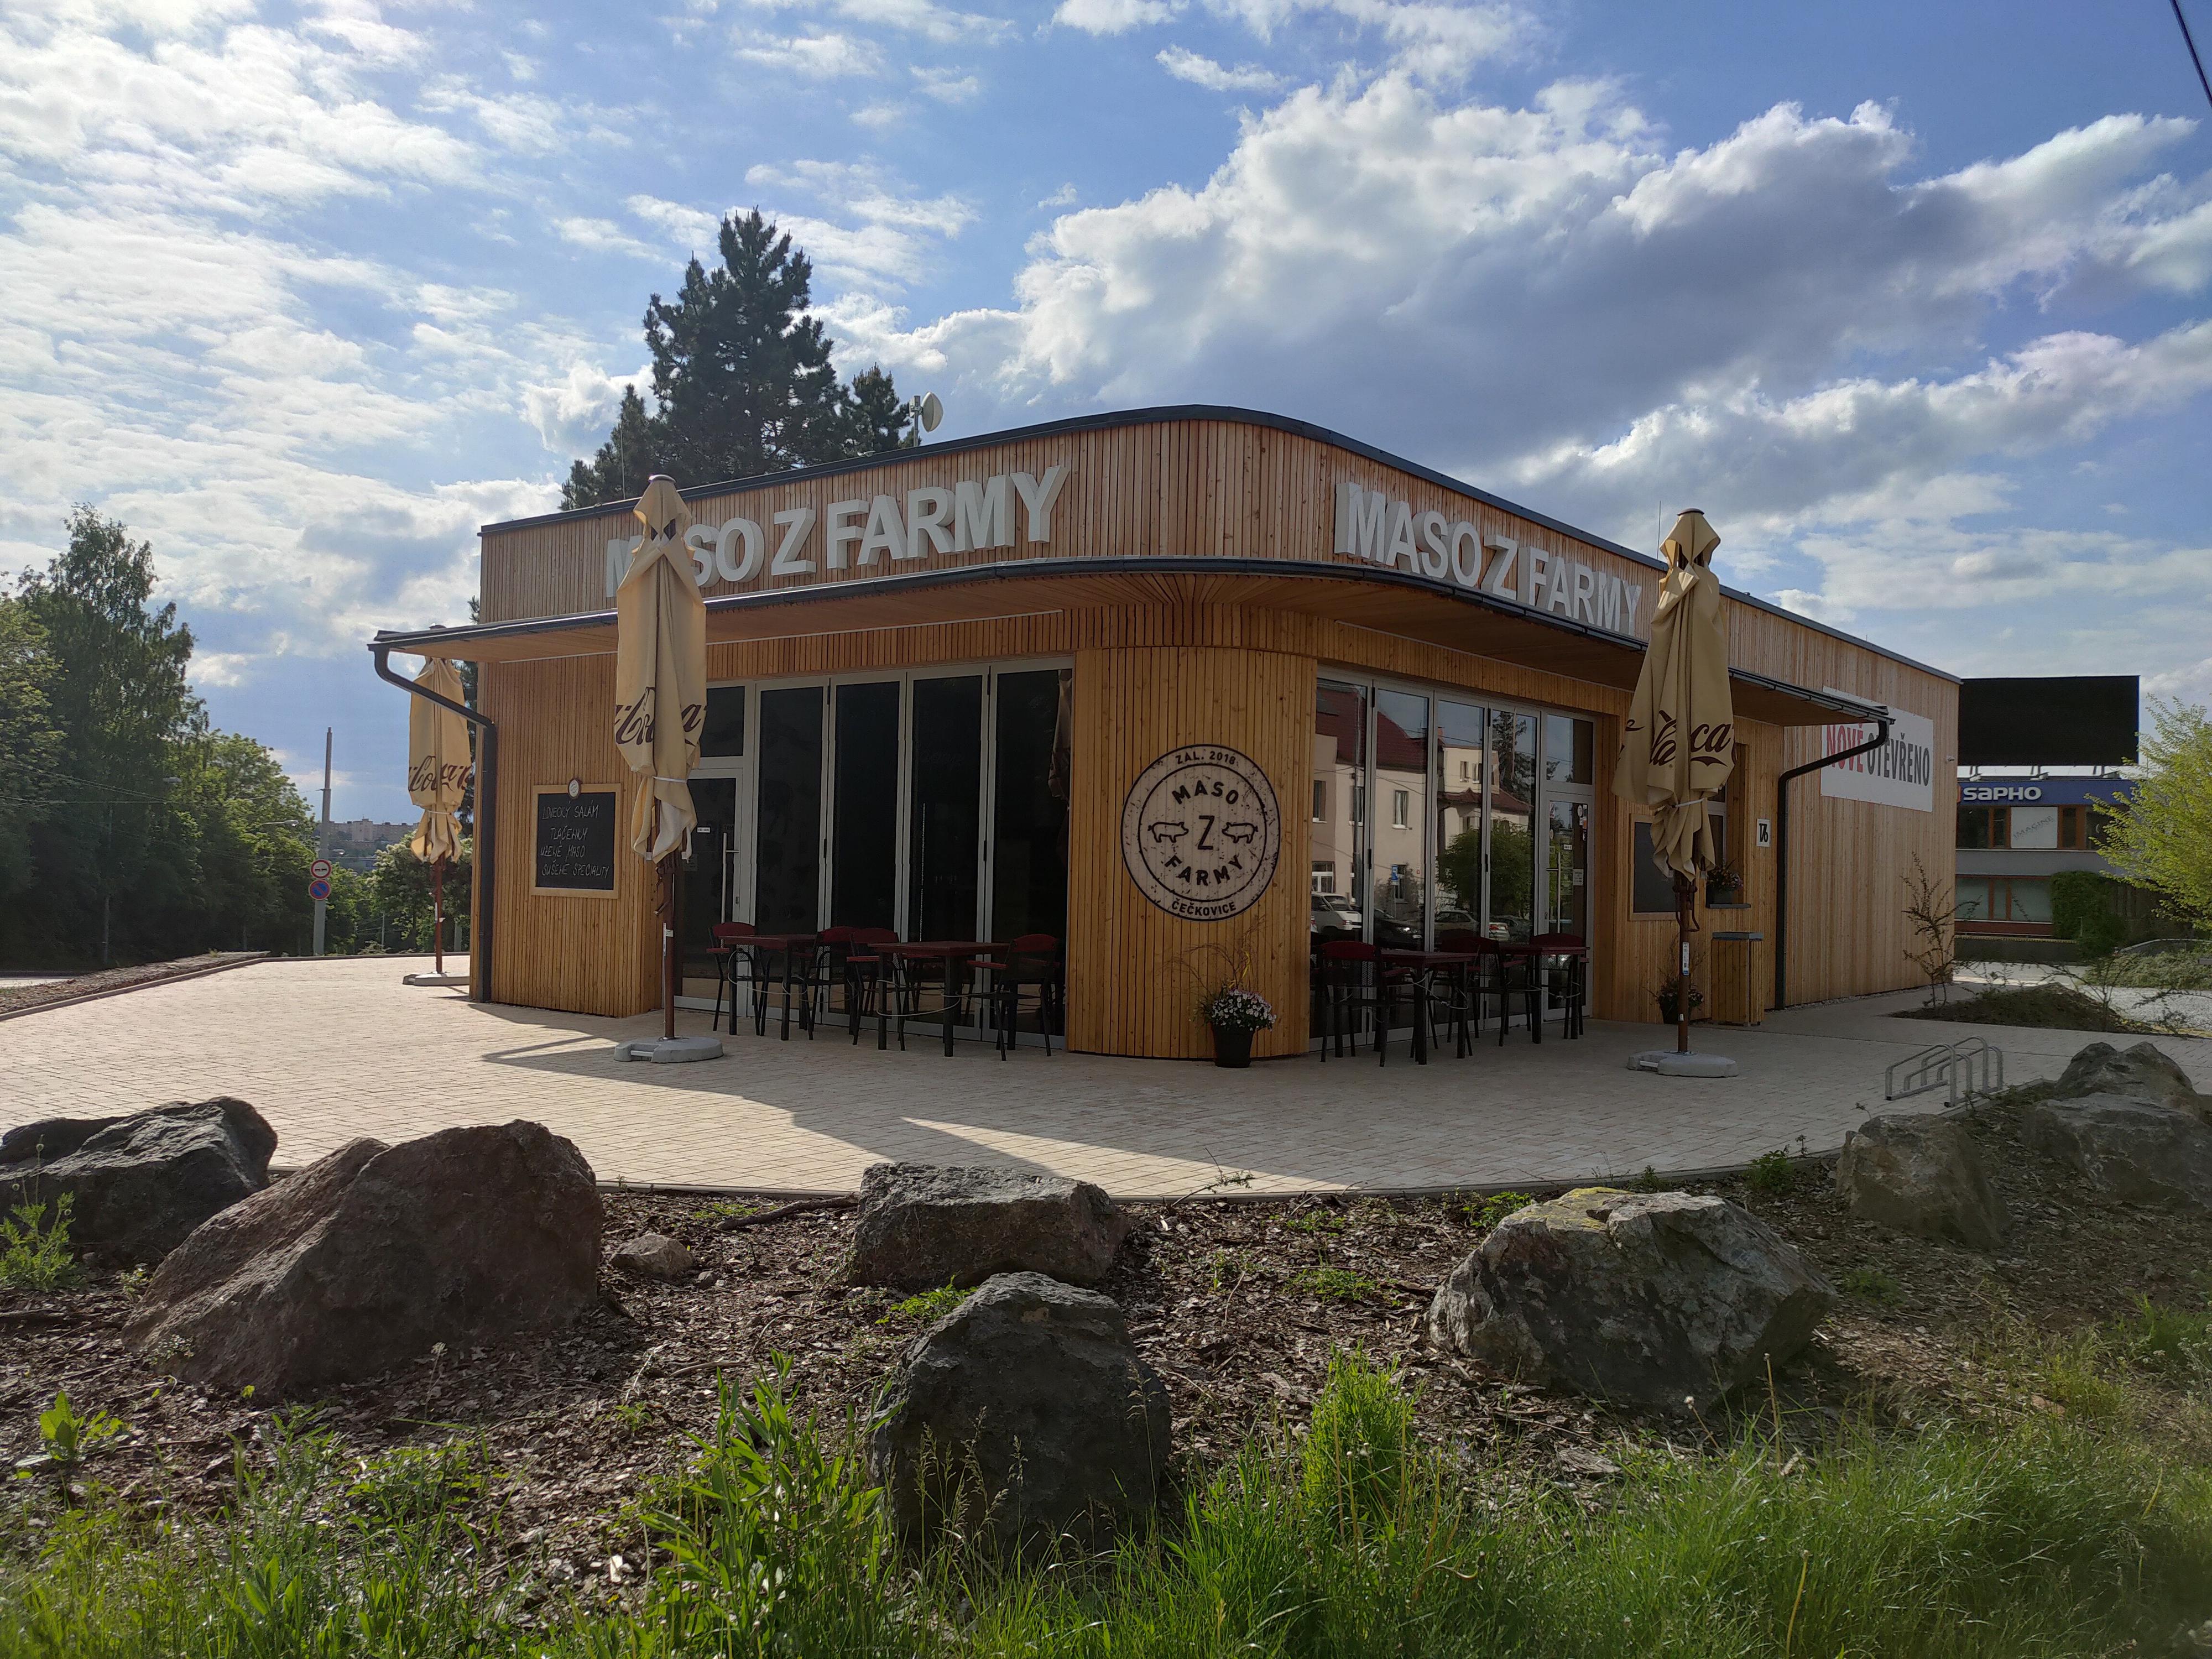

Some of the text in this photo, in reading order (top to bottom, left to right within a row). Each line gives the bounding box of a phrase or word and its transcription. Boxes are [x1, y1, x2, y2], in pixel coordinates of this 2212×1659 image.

[771, 508, 816, 576] Z
[827, 465, 1070, 570] FARMY
[1334, 482, 1642, 635] MASO Z FARMY
[1175, 750, 1237, 765] ZAL. 2018
[1867, 733, 1930, 786] OTEVŘENO
[1171, 780, 1239, 805] MASO
[1197, 815, 1215, 851] Z
[2012, 815, 2054, 839] IMAGINE
[1165, 854, 1243, 886] FARMY
[1171, 898, 1237, 916] ČEČKOVICE
